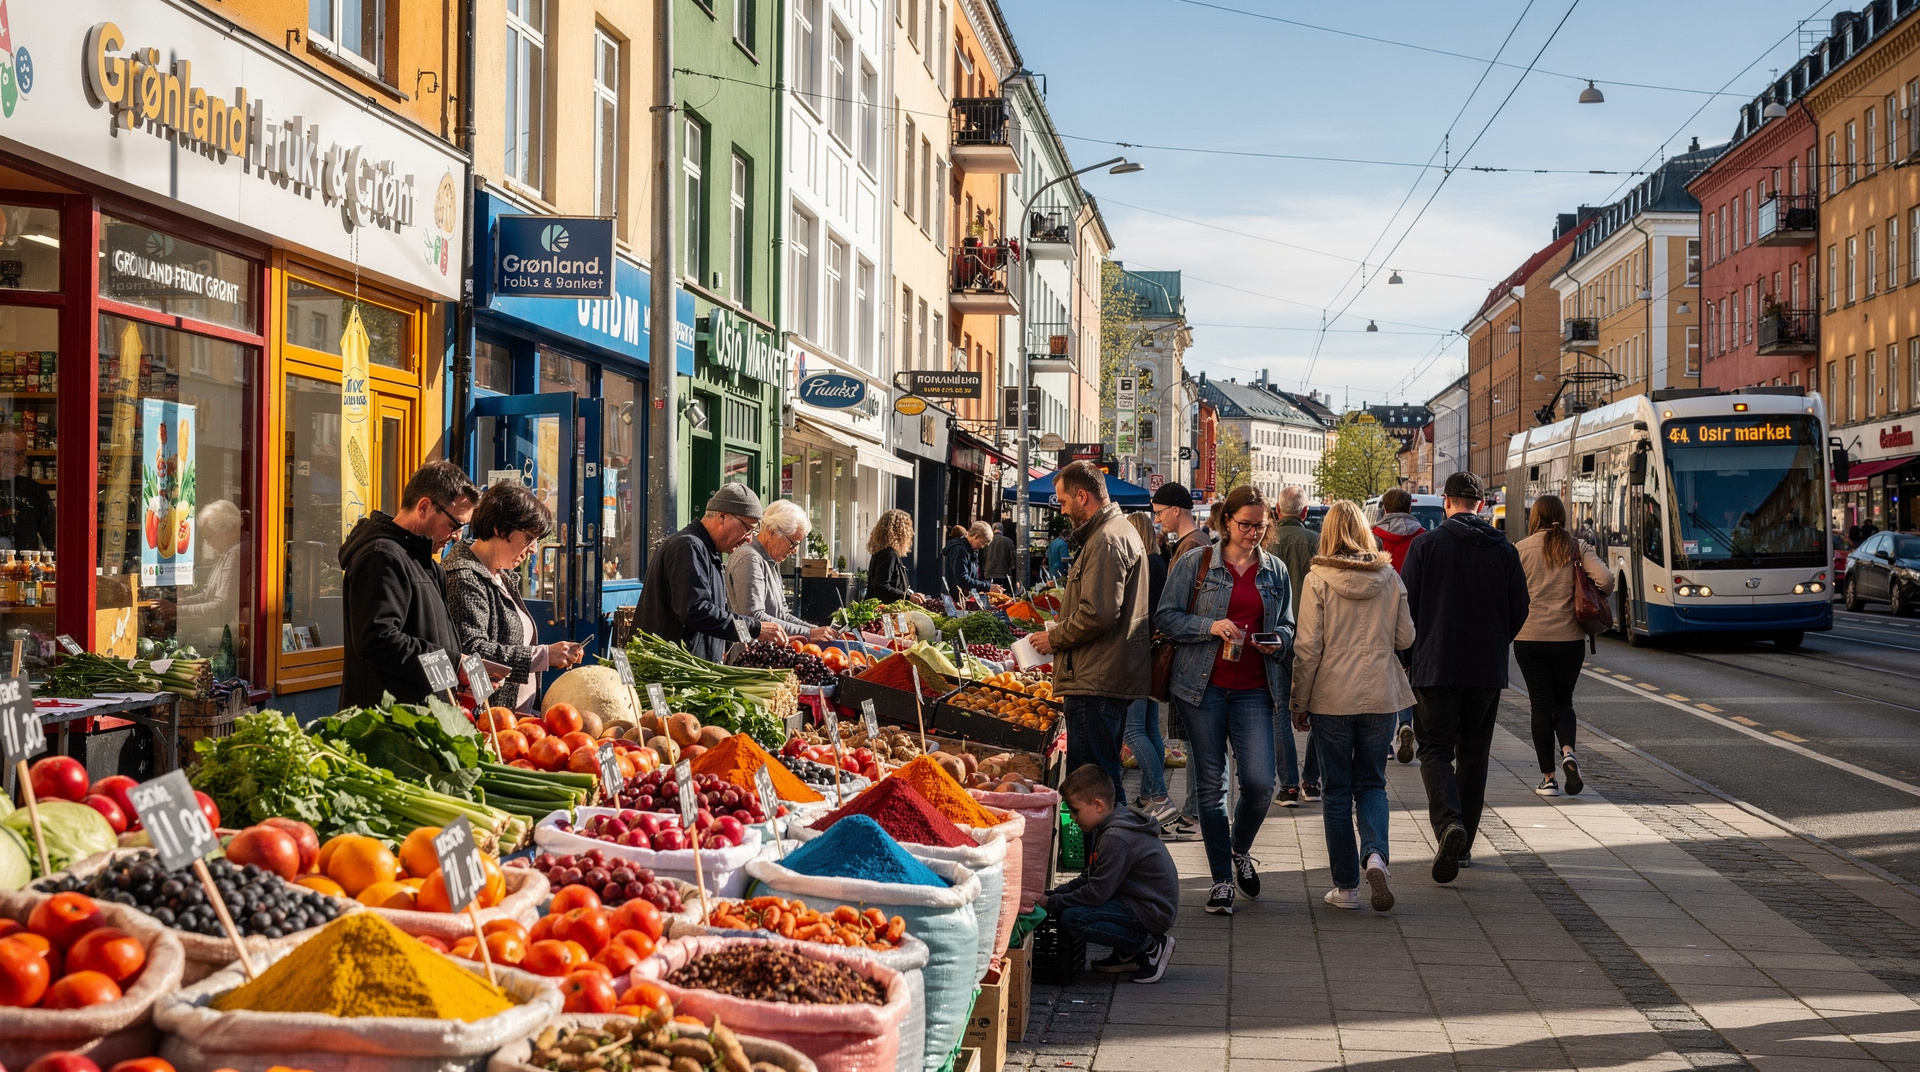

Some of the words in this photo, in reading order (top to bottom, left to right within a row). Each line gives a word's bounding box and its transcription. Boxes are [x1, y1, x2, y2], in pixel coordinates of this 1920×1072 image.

[502, 254, 603, 275] Grønland.
[543, 277, 552, 288] &
[1735, 423, 1792, 441] market
